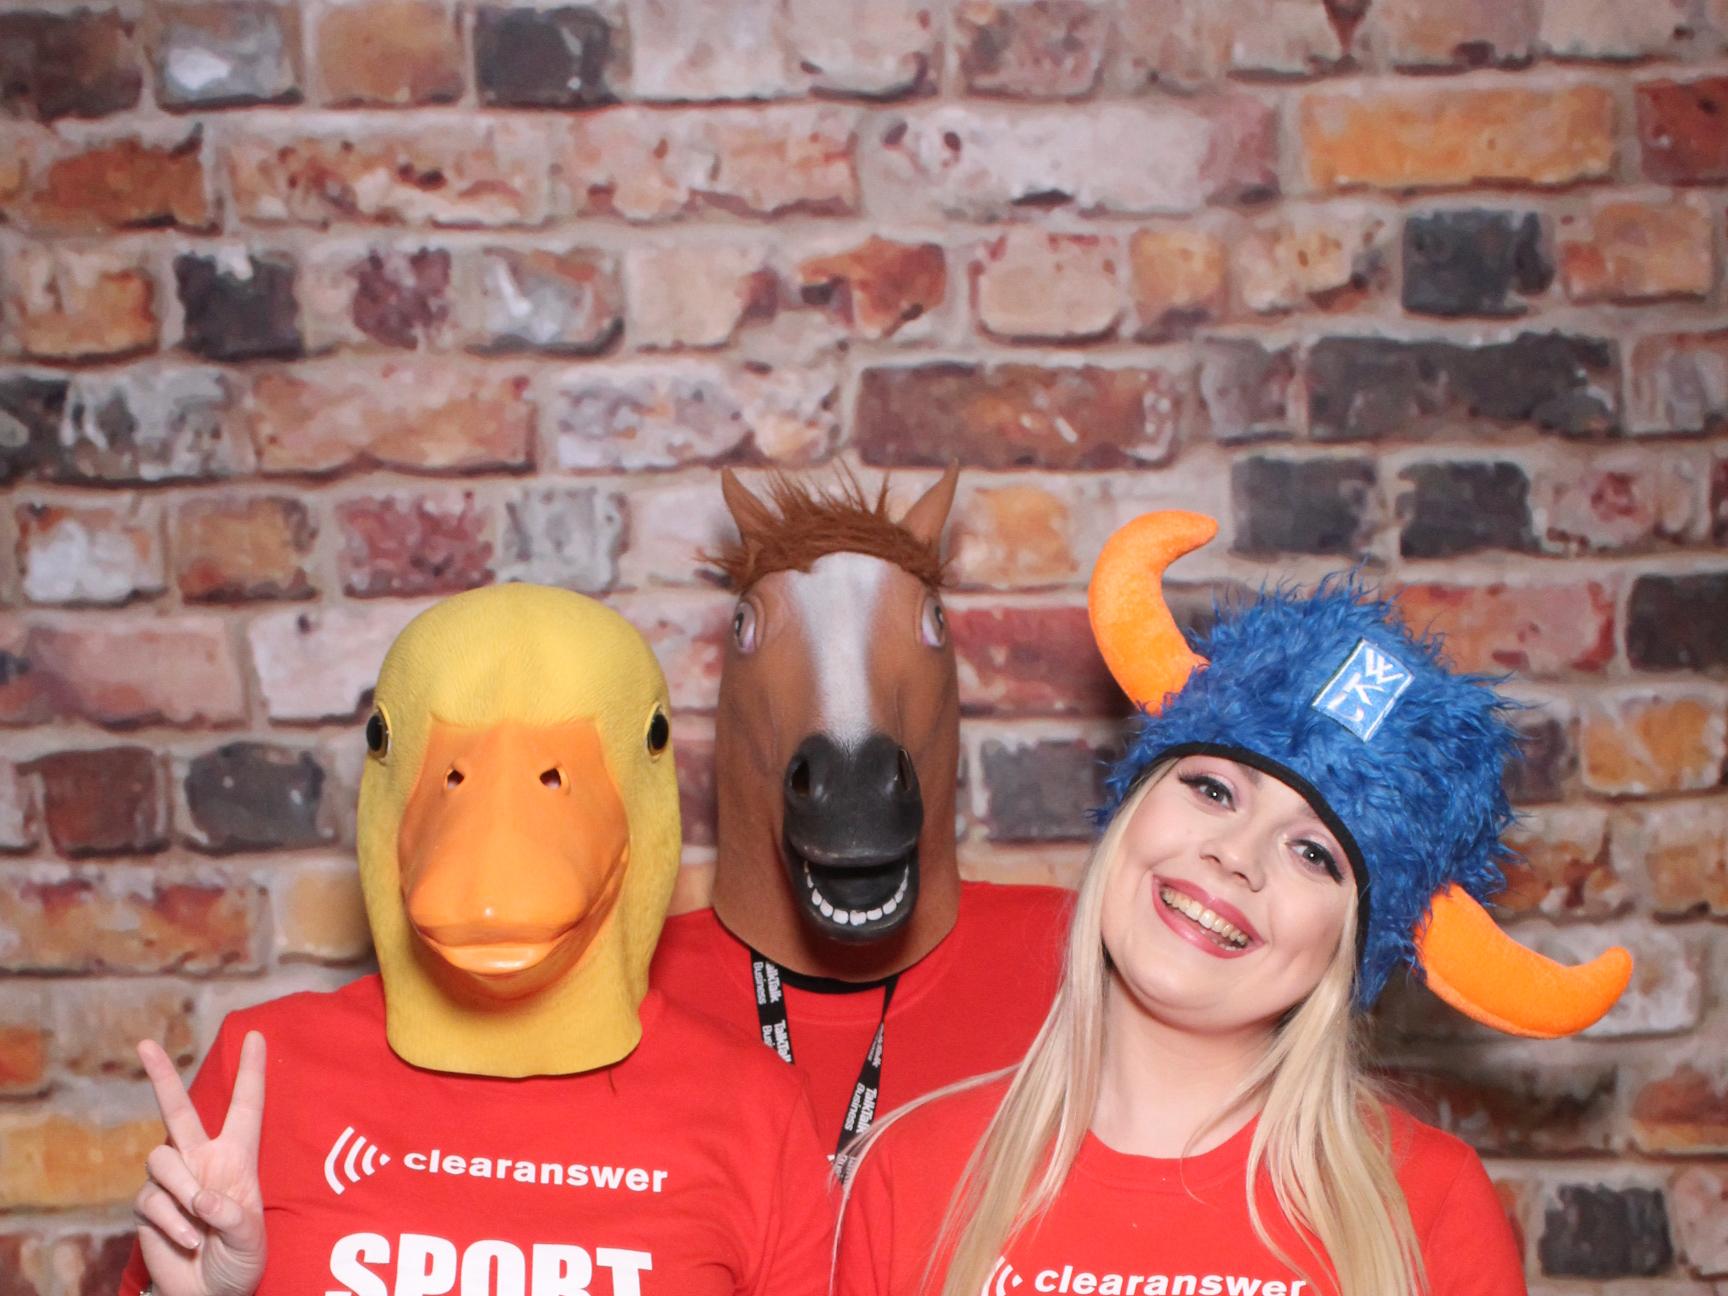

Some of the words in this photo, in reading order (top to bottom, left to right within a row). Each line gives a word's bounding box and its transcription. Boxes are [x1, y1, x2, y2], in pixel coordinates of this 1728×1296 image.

[753, 961, 767, 1004] Business
[765, 961, 782, 1003] alkTalk
[844, 1083, 866, 1132] Business
[855, 1088, 878, 1134] TalkTalk
[403, 1149, 668, 1193] clearanswer
